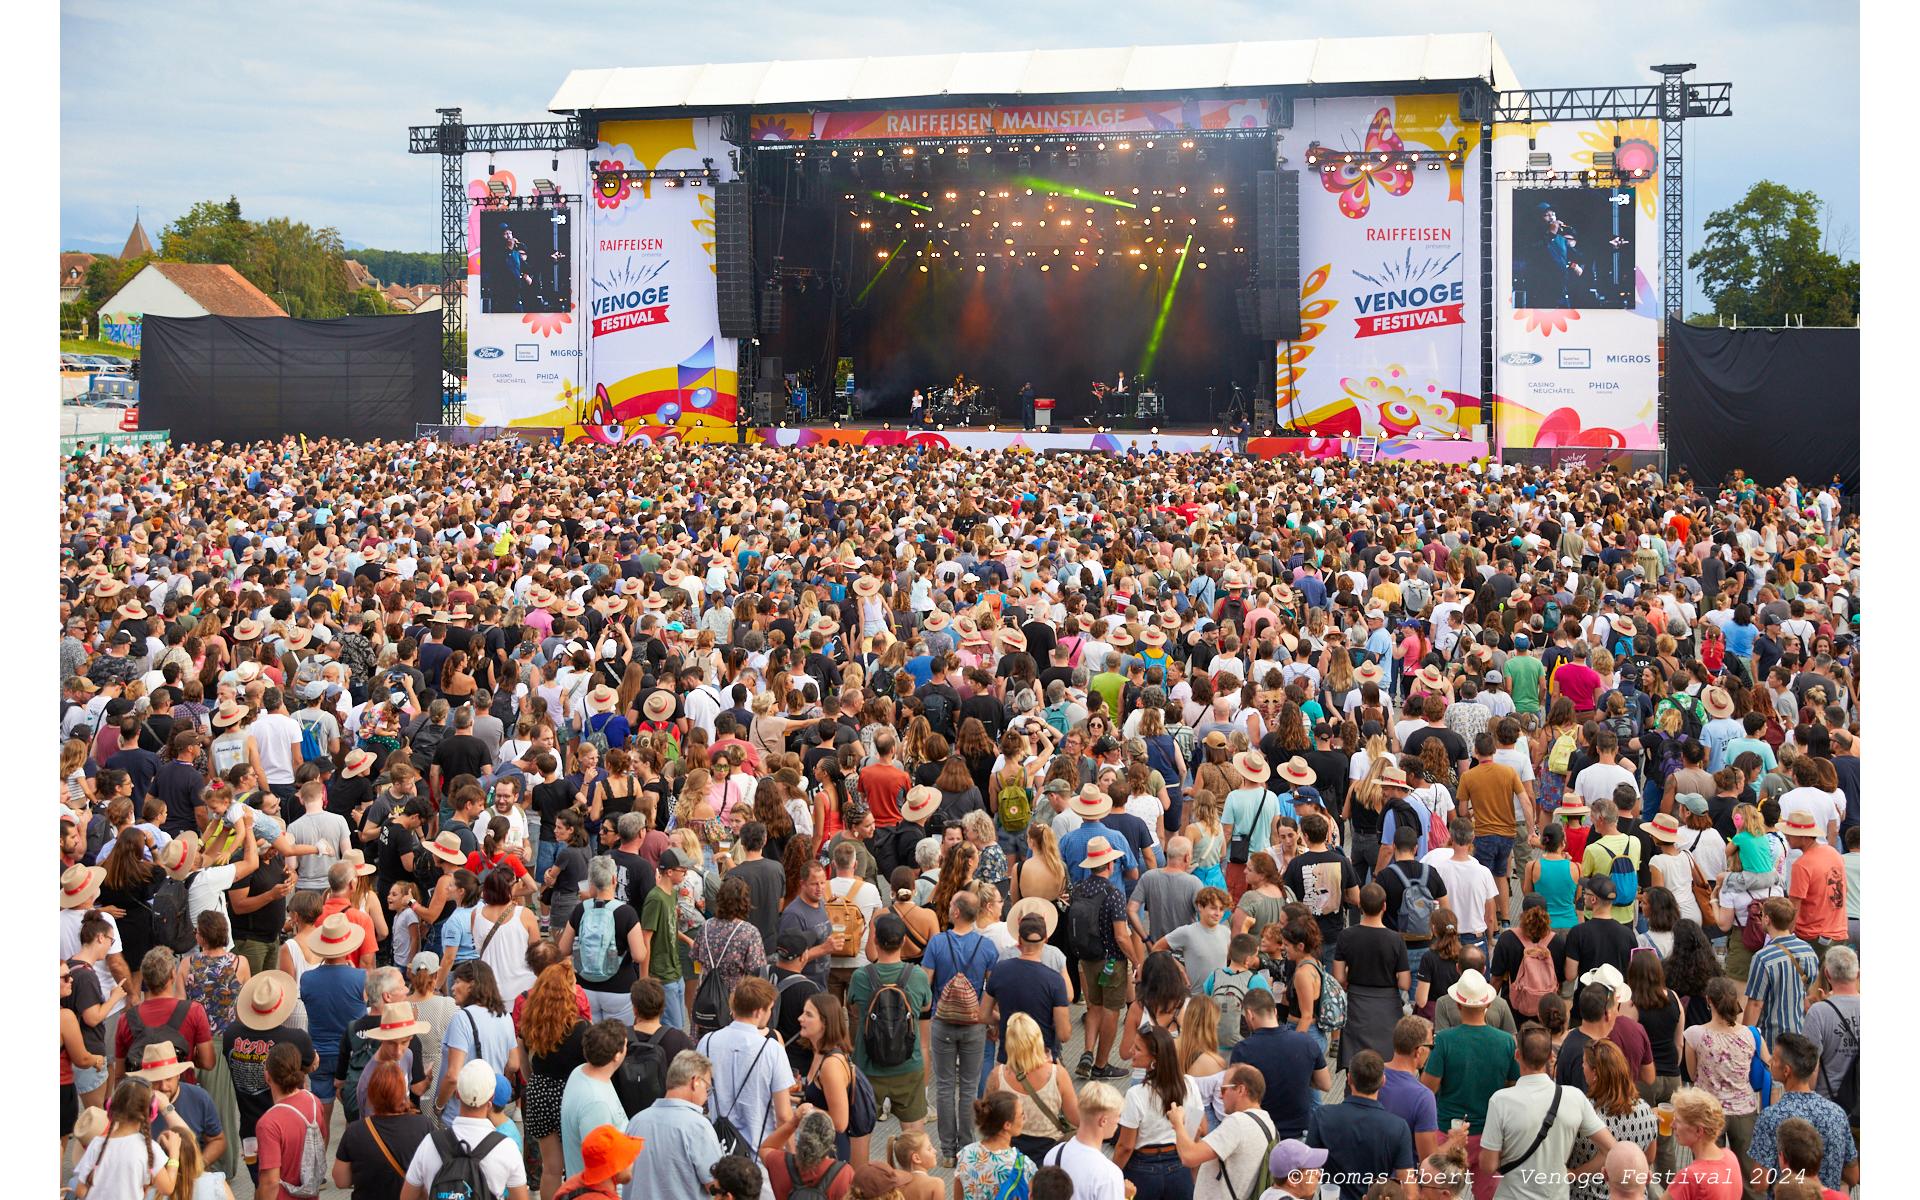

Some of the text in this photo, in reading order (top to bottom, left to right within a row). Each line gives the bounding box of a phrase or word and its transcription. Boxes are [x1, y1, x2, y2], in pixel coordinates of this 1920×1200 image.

[887, 108, 1126, 133] RAIFFEISEN MAINSTAGE
[1367, 228, 1451, 241] RAIFFEISEN
[600, 238, 663, 251] RAIFFEISEN
[591, 286, 669, 316] VENOGE
[1354, 281, 1463, 314] VENOGE
[601, 310, 654, 332] FESTIVAL
[1373, 309, 1447, 332] FESTIVAL
[550, 349, 583, 357] MIGROS
[1606, 355, 1651, 363] MIGROS
[1533, 386, 1575, 394] NEUCHÂTEL
[1589, 382, 1619, 390] PHIDA
